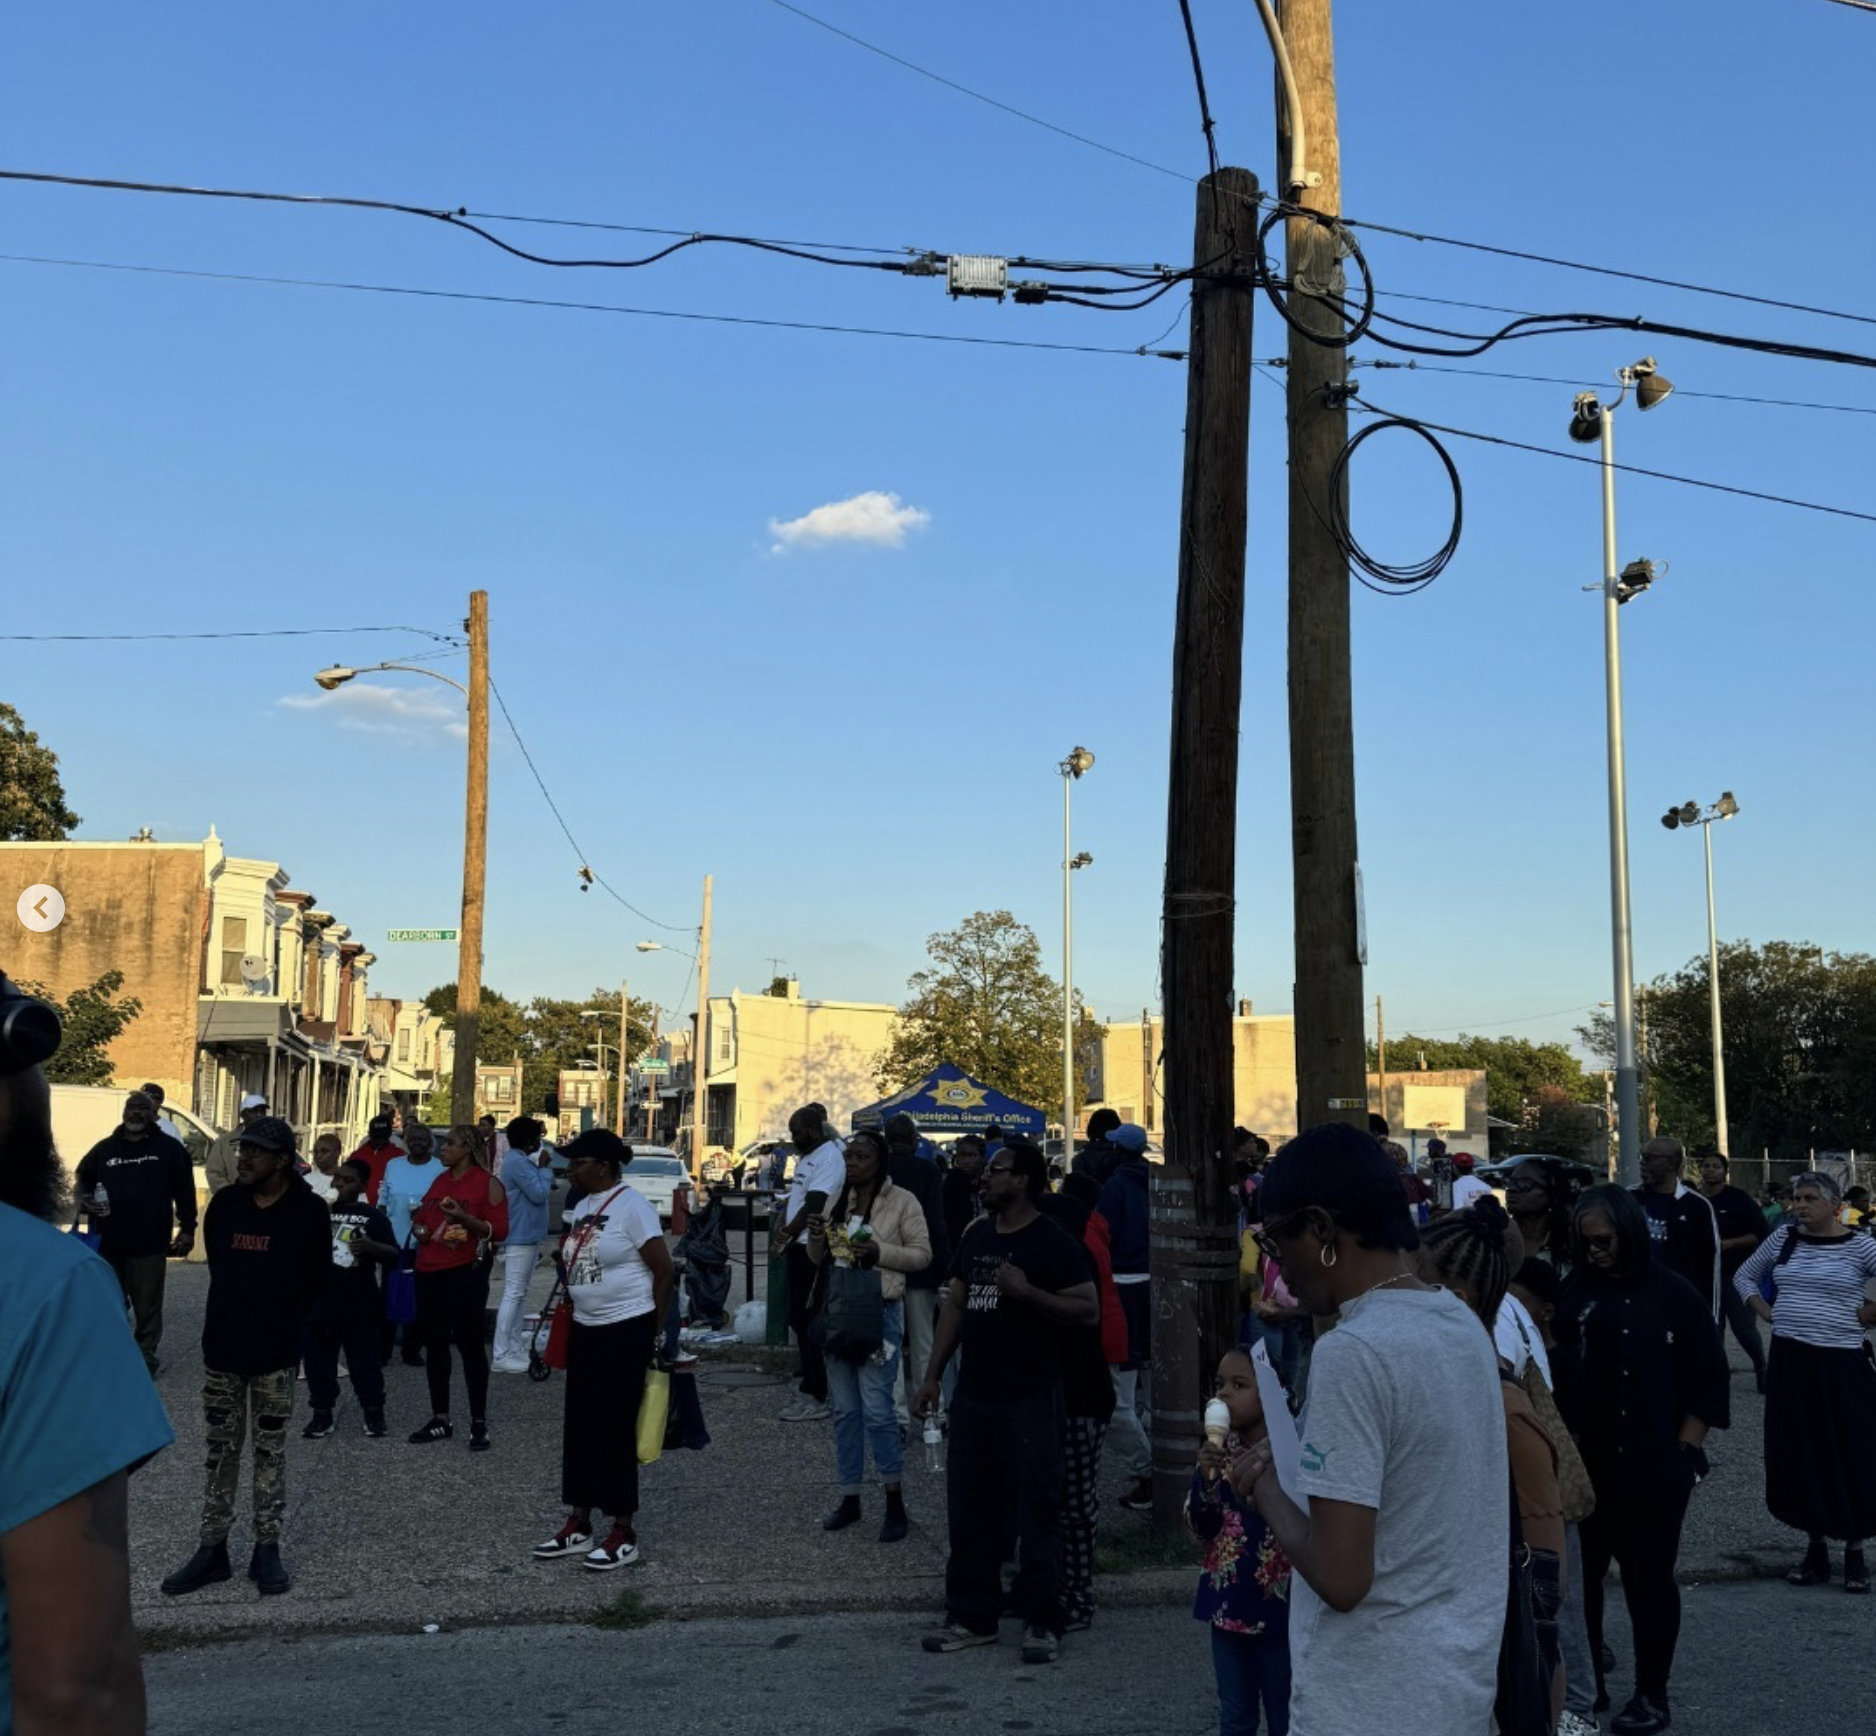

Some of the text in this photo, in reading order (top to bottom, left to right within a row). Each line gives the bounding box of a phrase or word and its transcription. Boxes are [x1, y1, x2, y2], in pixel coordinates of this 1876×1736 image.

[389, 931, 455, 940] DEARBORN ST
[961, 1110, 1001, 1122] Sheriff's
[1003, 1113, 1031, 1123] Office
[350, 1215, 370, 1224] BOY
